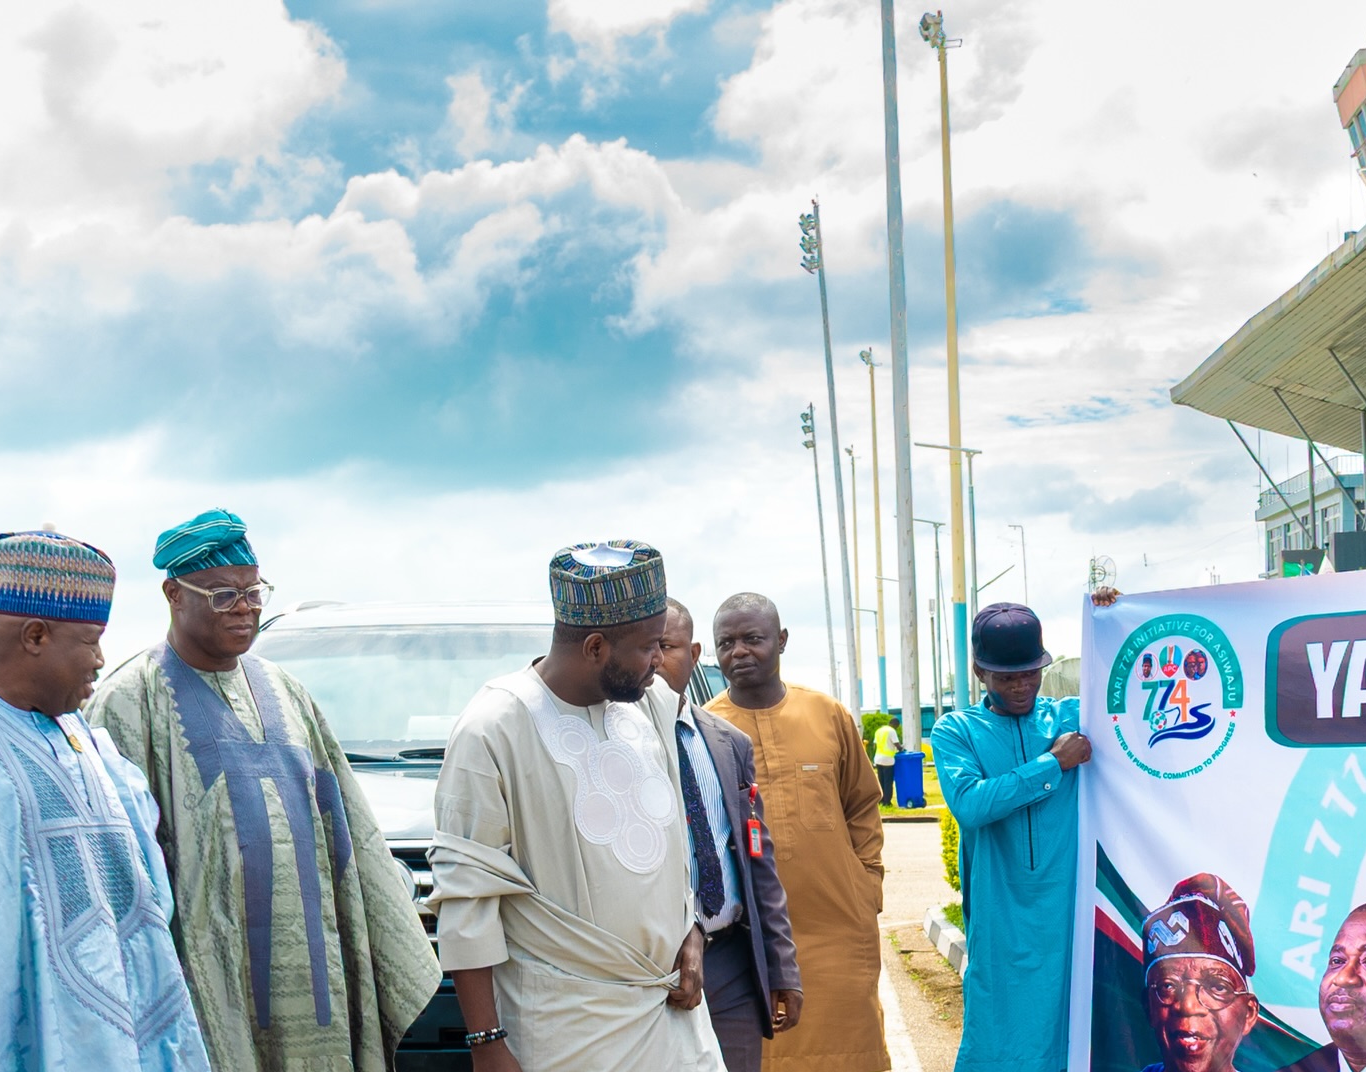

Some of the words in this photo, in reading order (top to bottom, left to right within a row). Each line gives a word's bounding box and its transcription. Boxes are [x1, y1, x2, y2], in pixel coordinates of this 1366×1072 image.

[1113, 676, 1123, 706] YARI
[1119, 649, 1135, 671] 774
[1133, 621, 1191, 648] INITIATIVE
[1194, 624, 1214, 643] FOR
[1213, 644, 1236, 701] ASIWAJU
[1163, 665, 1177, 673] APC
[1142, 679, 1190, 722] 774
[1115, 725, 1128, 751] UNITED
[1127, 750, 1134, 759] IN
[1133, 757, 1161, 779] PURPOSE,
[1163, 765, 1203, 779] COMMITTED
[1203, 758, 1213, 767] TO
[1212, 722, 1235, 760] PROGRESS
